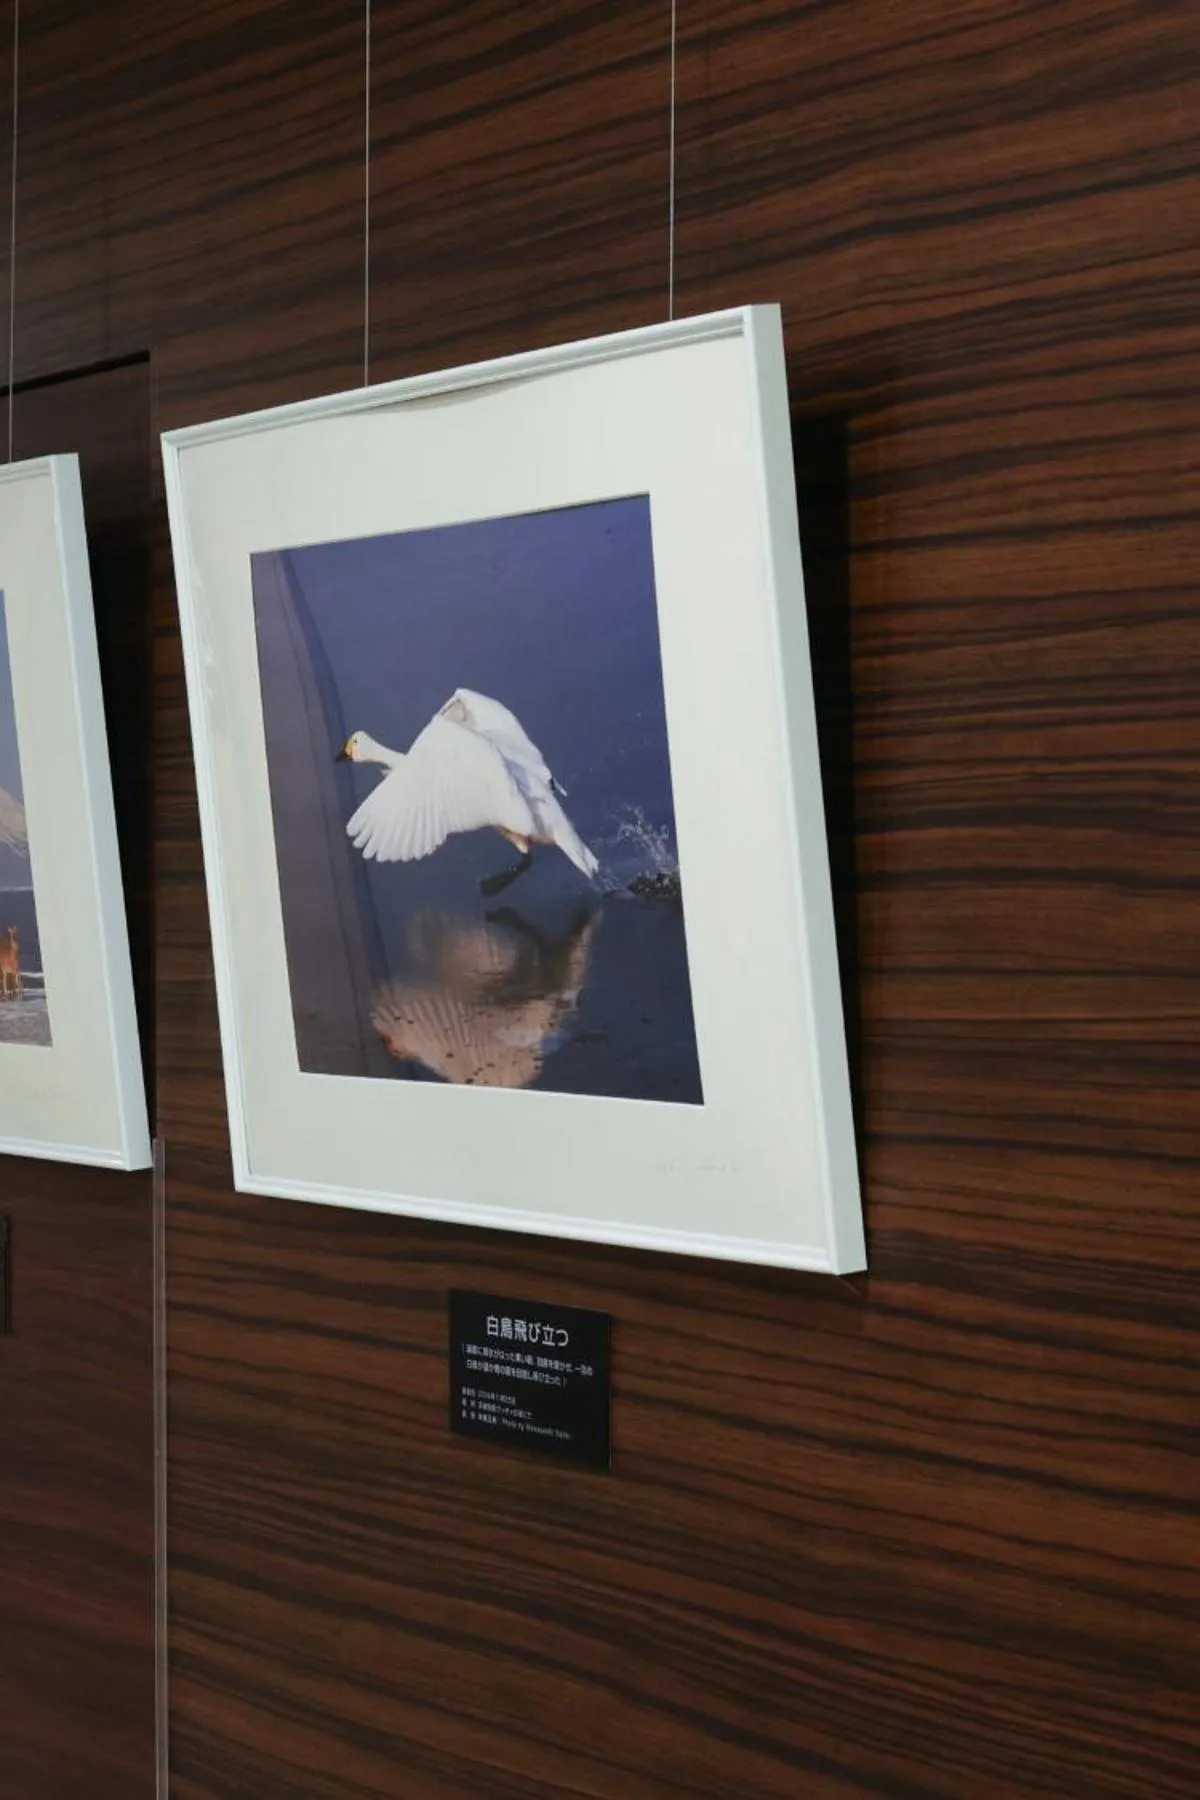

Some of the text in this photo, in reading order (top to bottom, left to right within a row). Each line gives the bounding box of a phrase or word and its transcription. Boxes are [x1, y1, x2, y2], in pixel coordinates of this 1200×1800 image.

[486, 1315, 569, 1347] 白鳥飛び立つ
